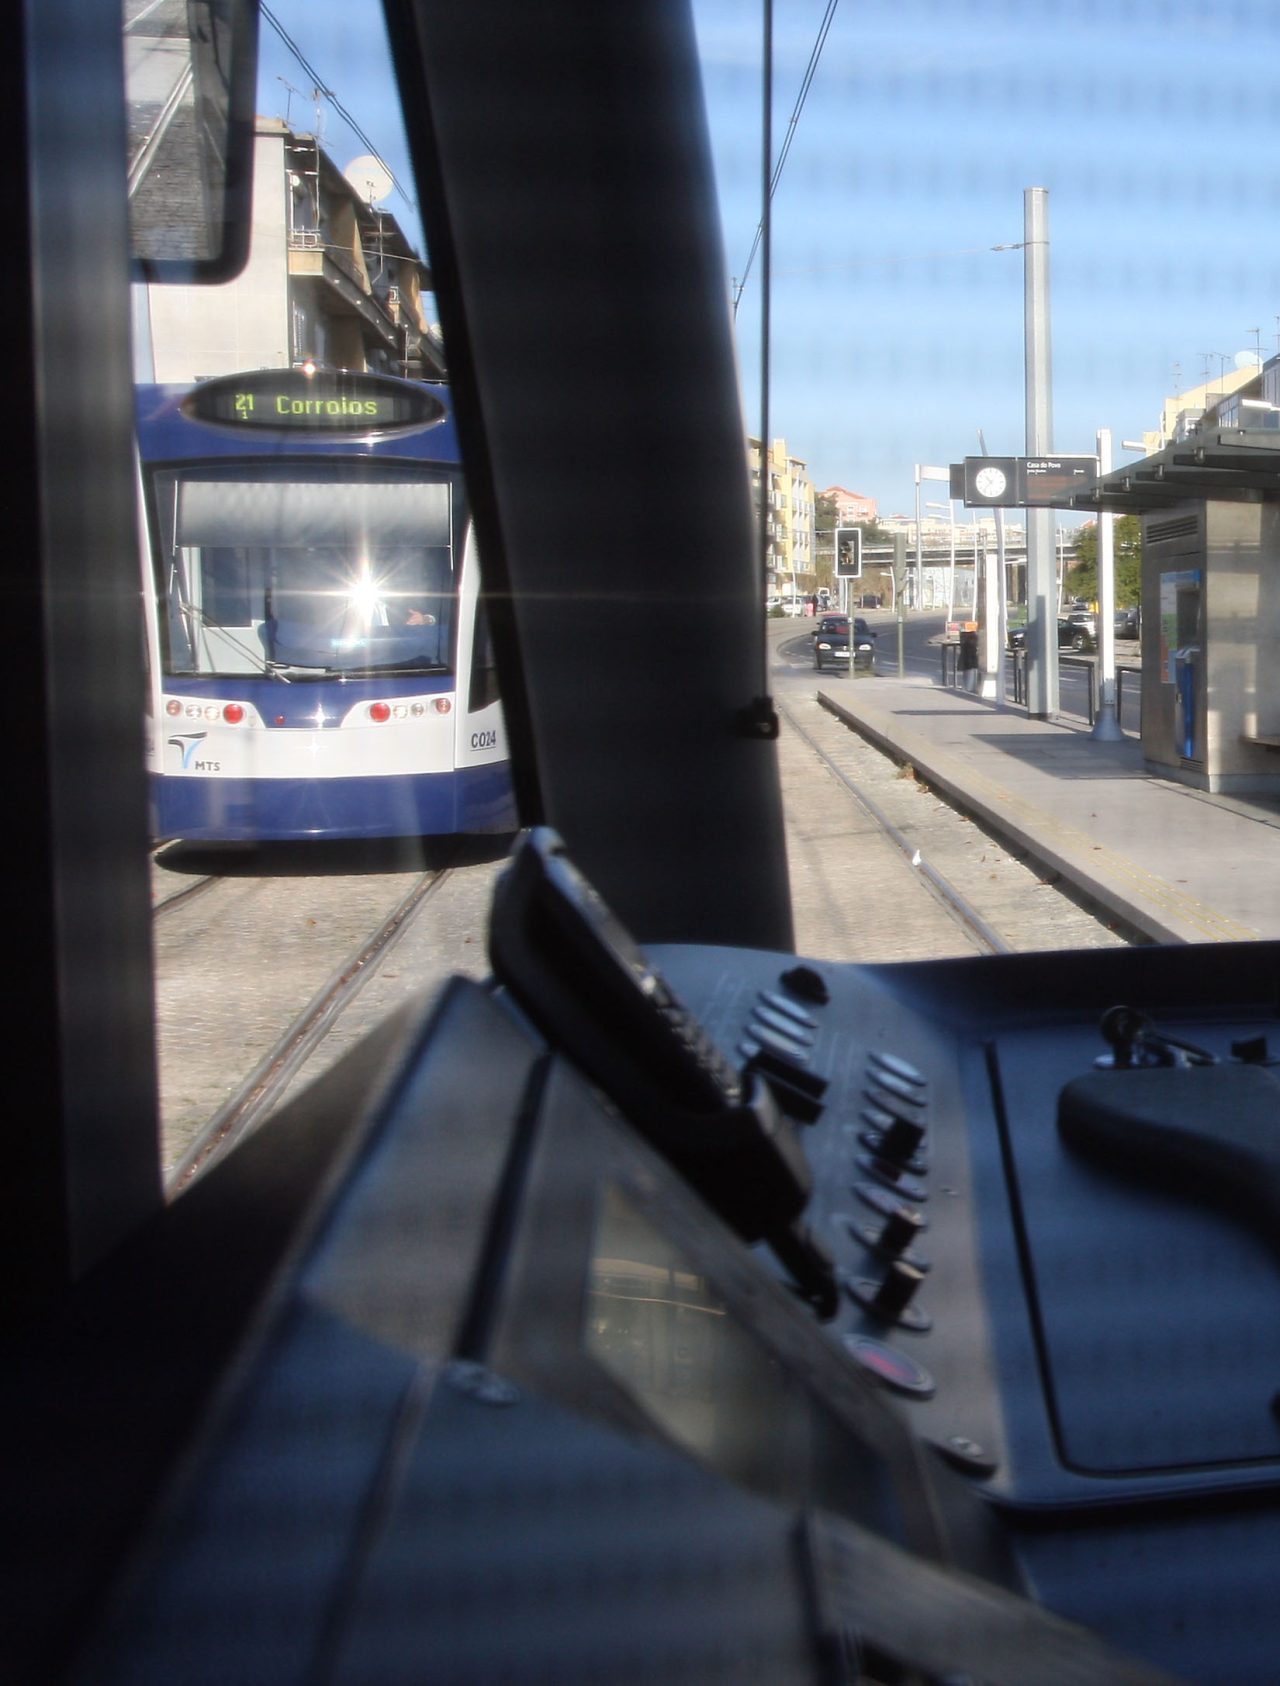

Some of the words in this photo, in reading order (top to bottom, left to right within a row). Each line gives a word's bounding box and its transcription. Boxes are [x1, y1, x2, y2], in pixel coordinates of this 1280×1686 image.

[235, 394, 254, 411] 21
[276, 395, 377, 415] Corroios
[194, 760, 220, 771] MTS
